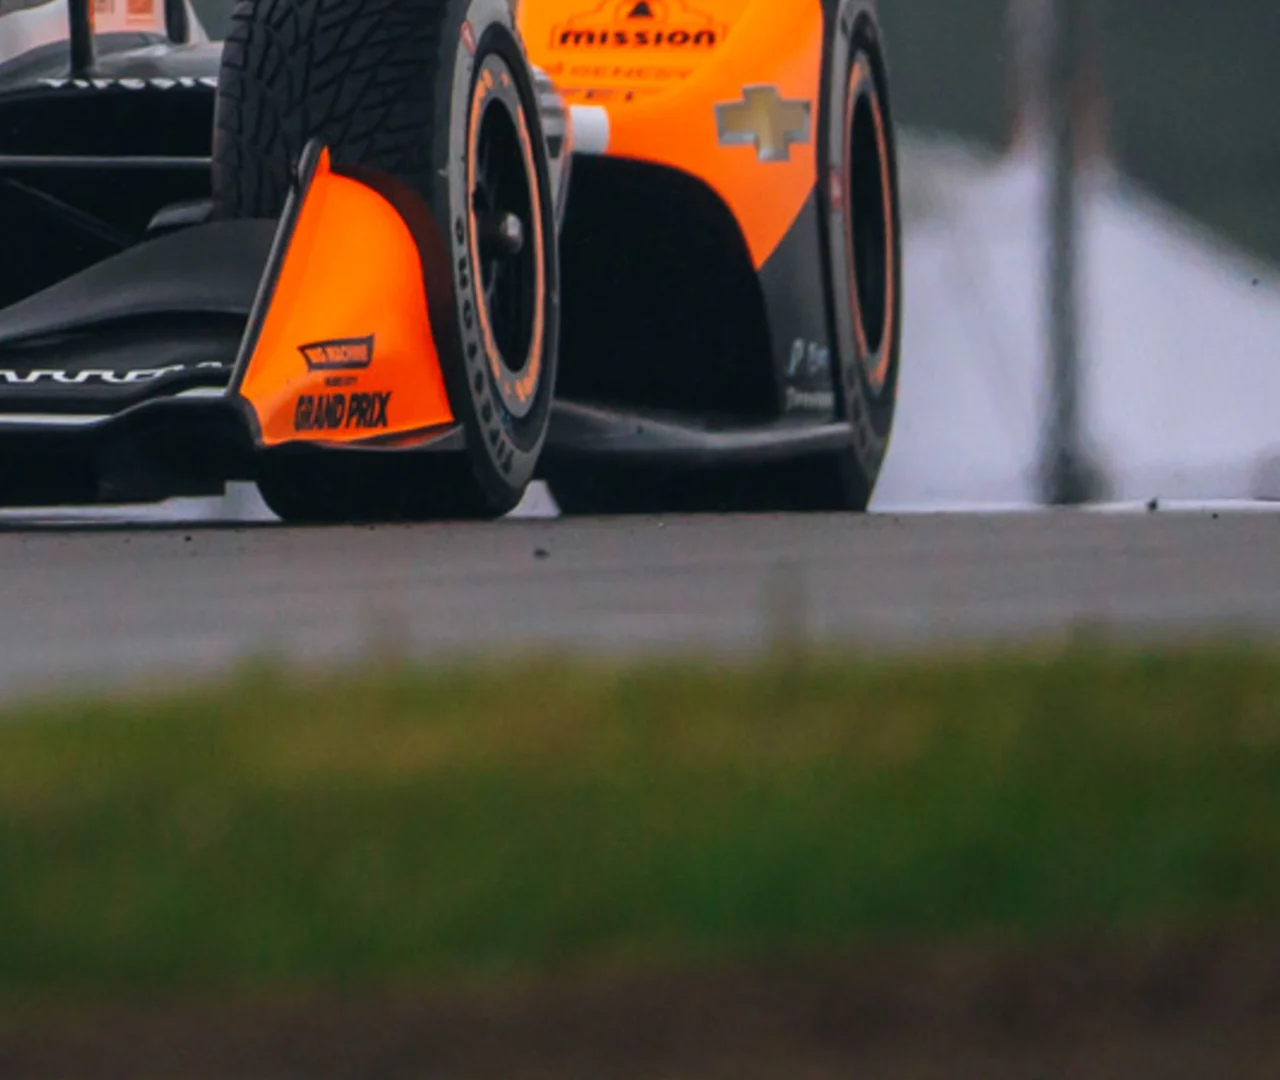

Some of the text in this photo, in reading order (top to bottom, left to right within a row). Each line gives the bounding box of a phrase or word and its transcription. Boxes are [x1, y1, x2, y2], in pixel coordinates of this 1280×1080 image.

[559, 29, 716, 46] mission
[294, 389, 393, 432] GRAND PRIX
